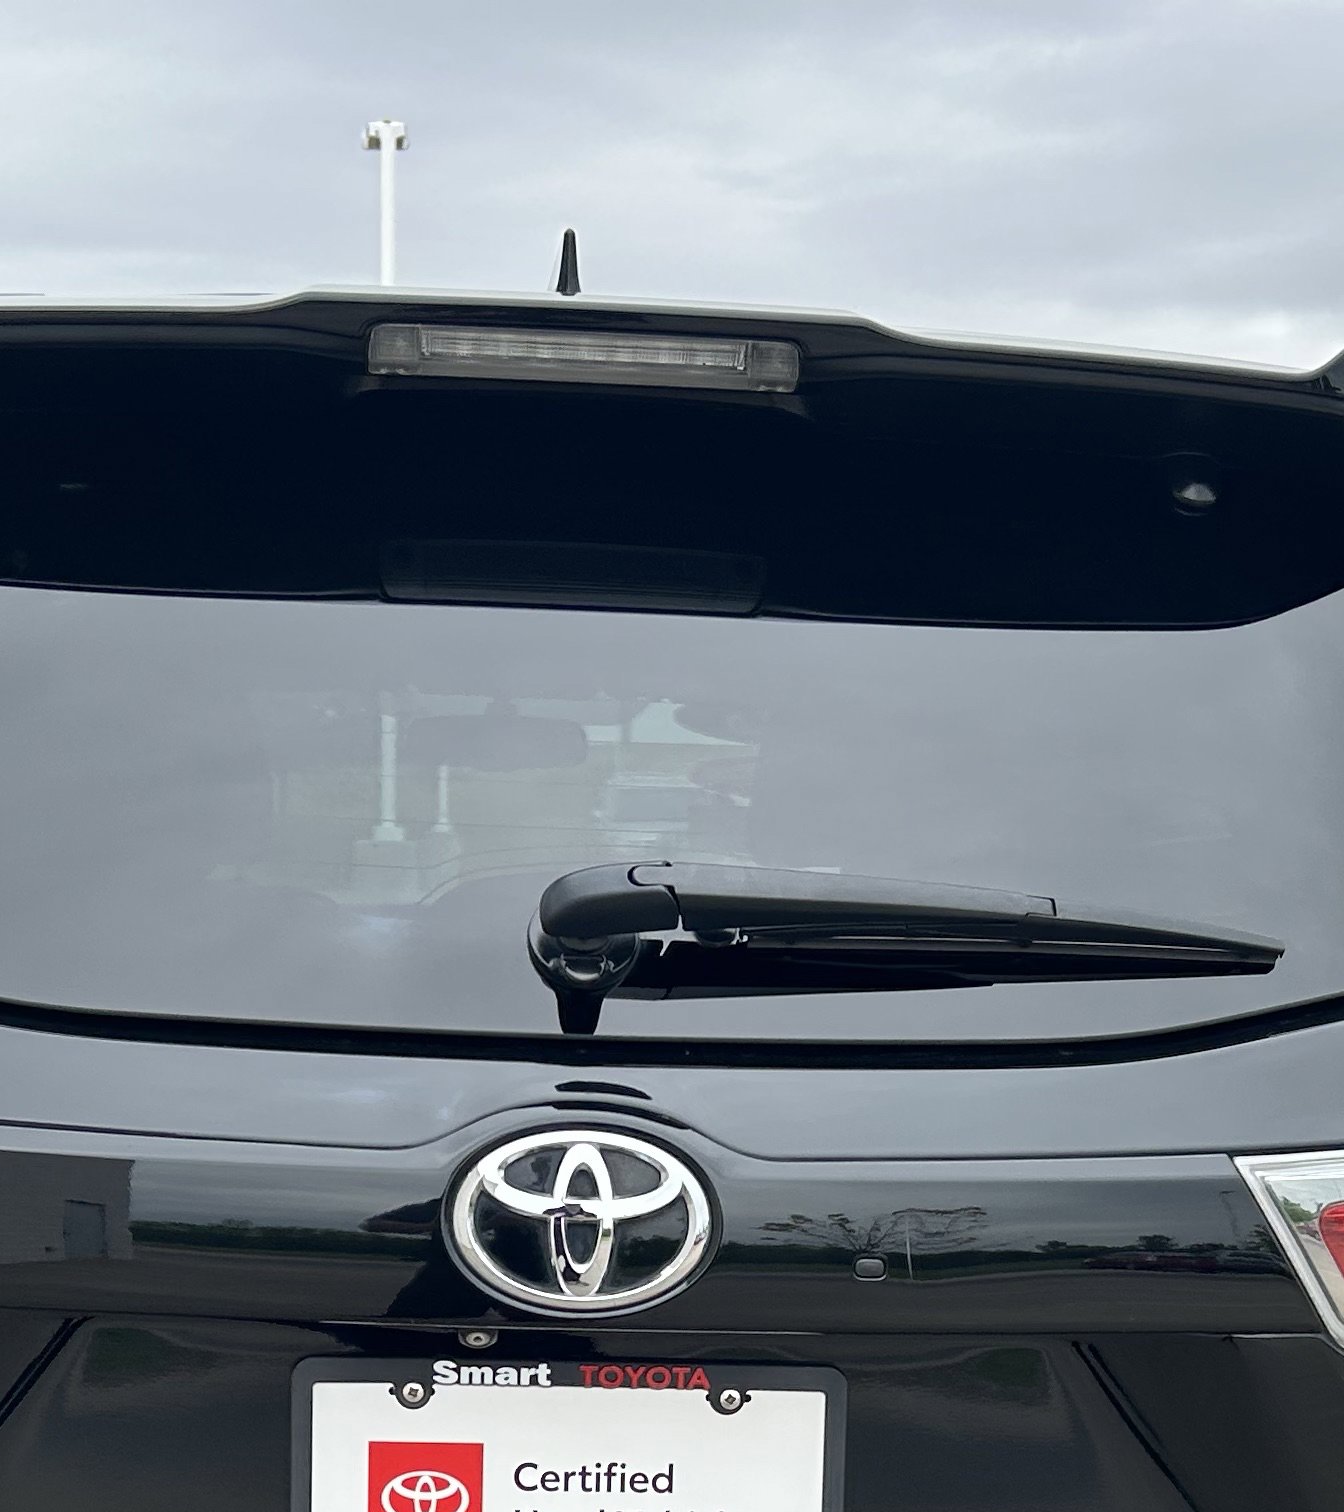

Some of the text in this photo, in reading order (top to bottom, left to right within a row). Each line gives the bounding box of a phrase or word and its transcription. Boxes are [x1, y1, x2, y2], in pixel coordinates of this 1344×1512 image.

[432, 1360, 711, 1390] Smart TOYOTA
[513, 1462, 674, 1494] Certified
